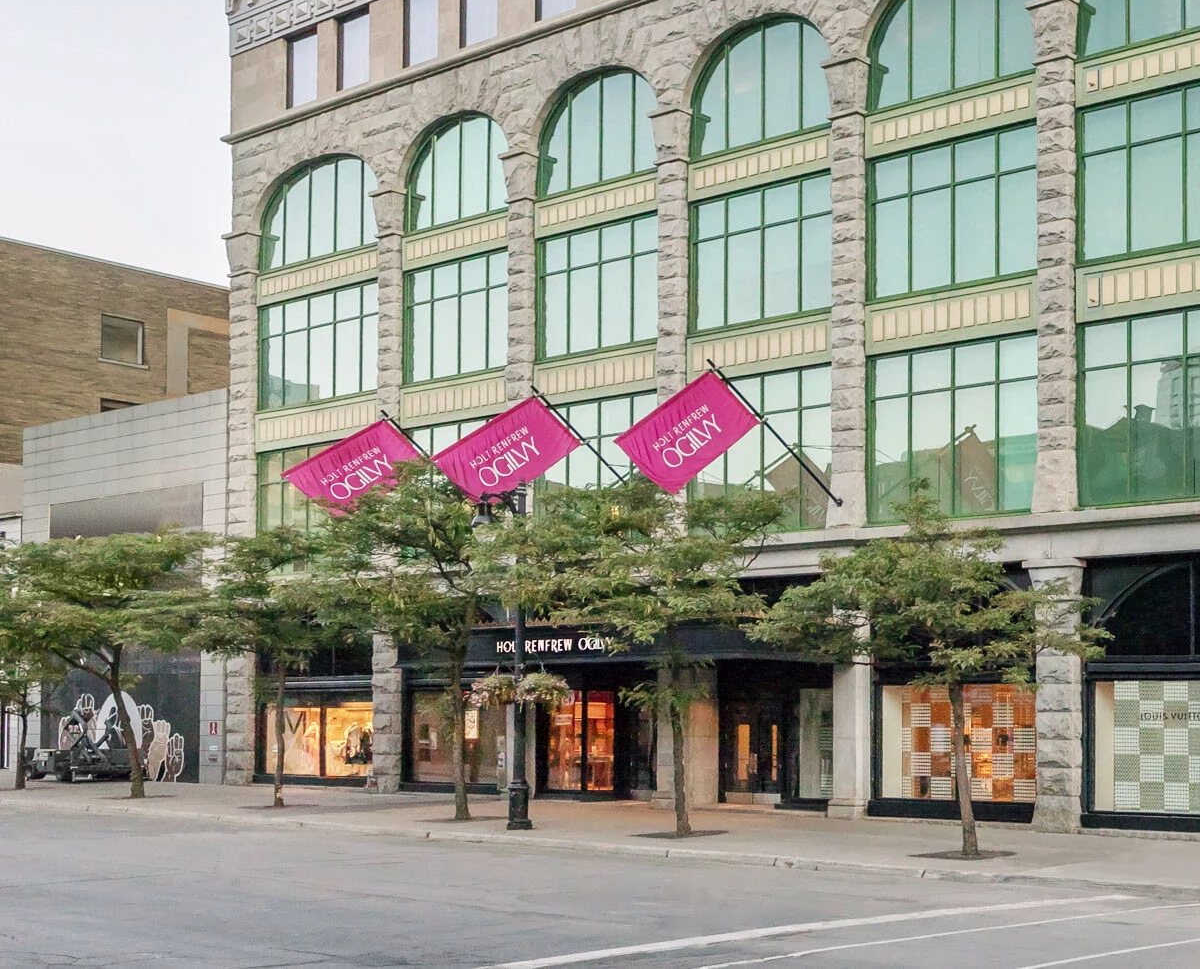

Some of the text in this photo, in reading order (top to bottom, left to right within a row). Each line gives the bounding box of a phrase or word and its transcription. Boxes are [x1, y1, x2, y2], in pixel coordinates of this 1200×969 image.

[469, 426, 529, 470] HOLT RENFREW
[652, 404, 710, 452] HOLT RENFREW
[662, 413, 722, 468] OGILVY
[320, 446, 381, 486] HOLT RENFREW
[330, 454, 393, 500] OGILVY
[479, 436, 540, 487] OGILVY
[496, 641, 517, 653] HOL
[524, 638, 573, 653] RENFREW
[1140, 711, 1168, 721] LOUIS
